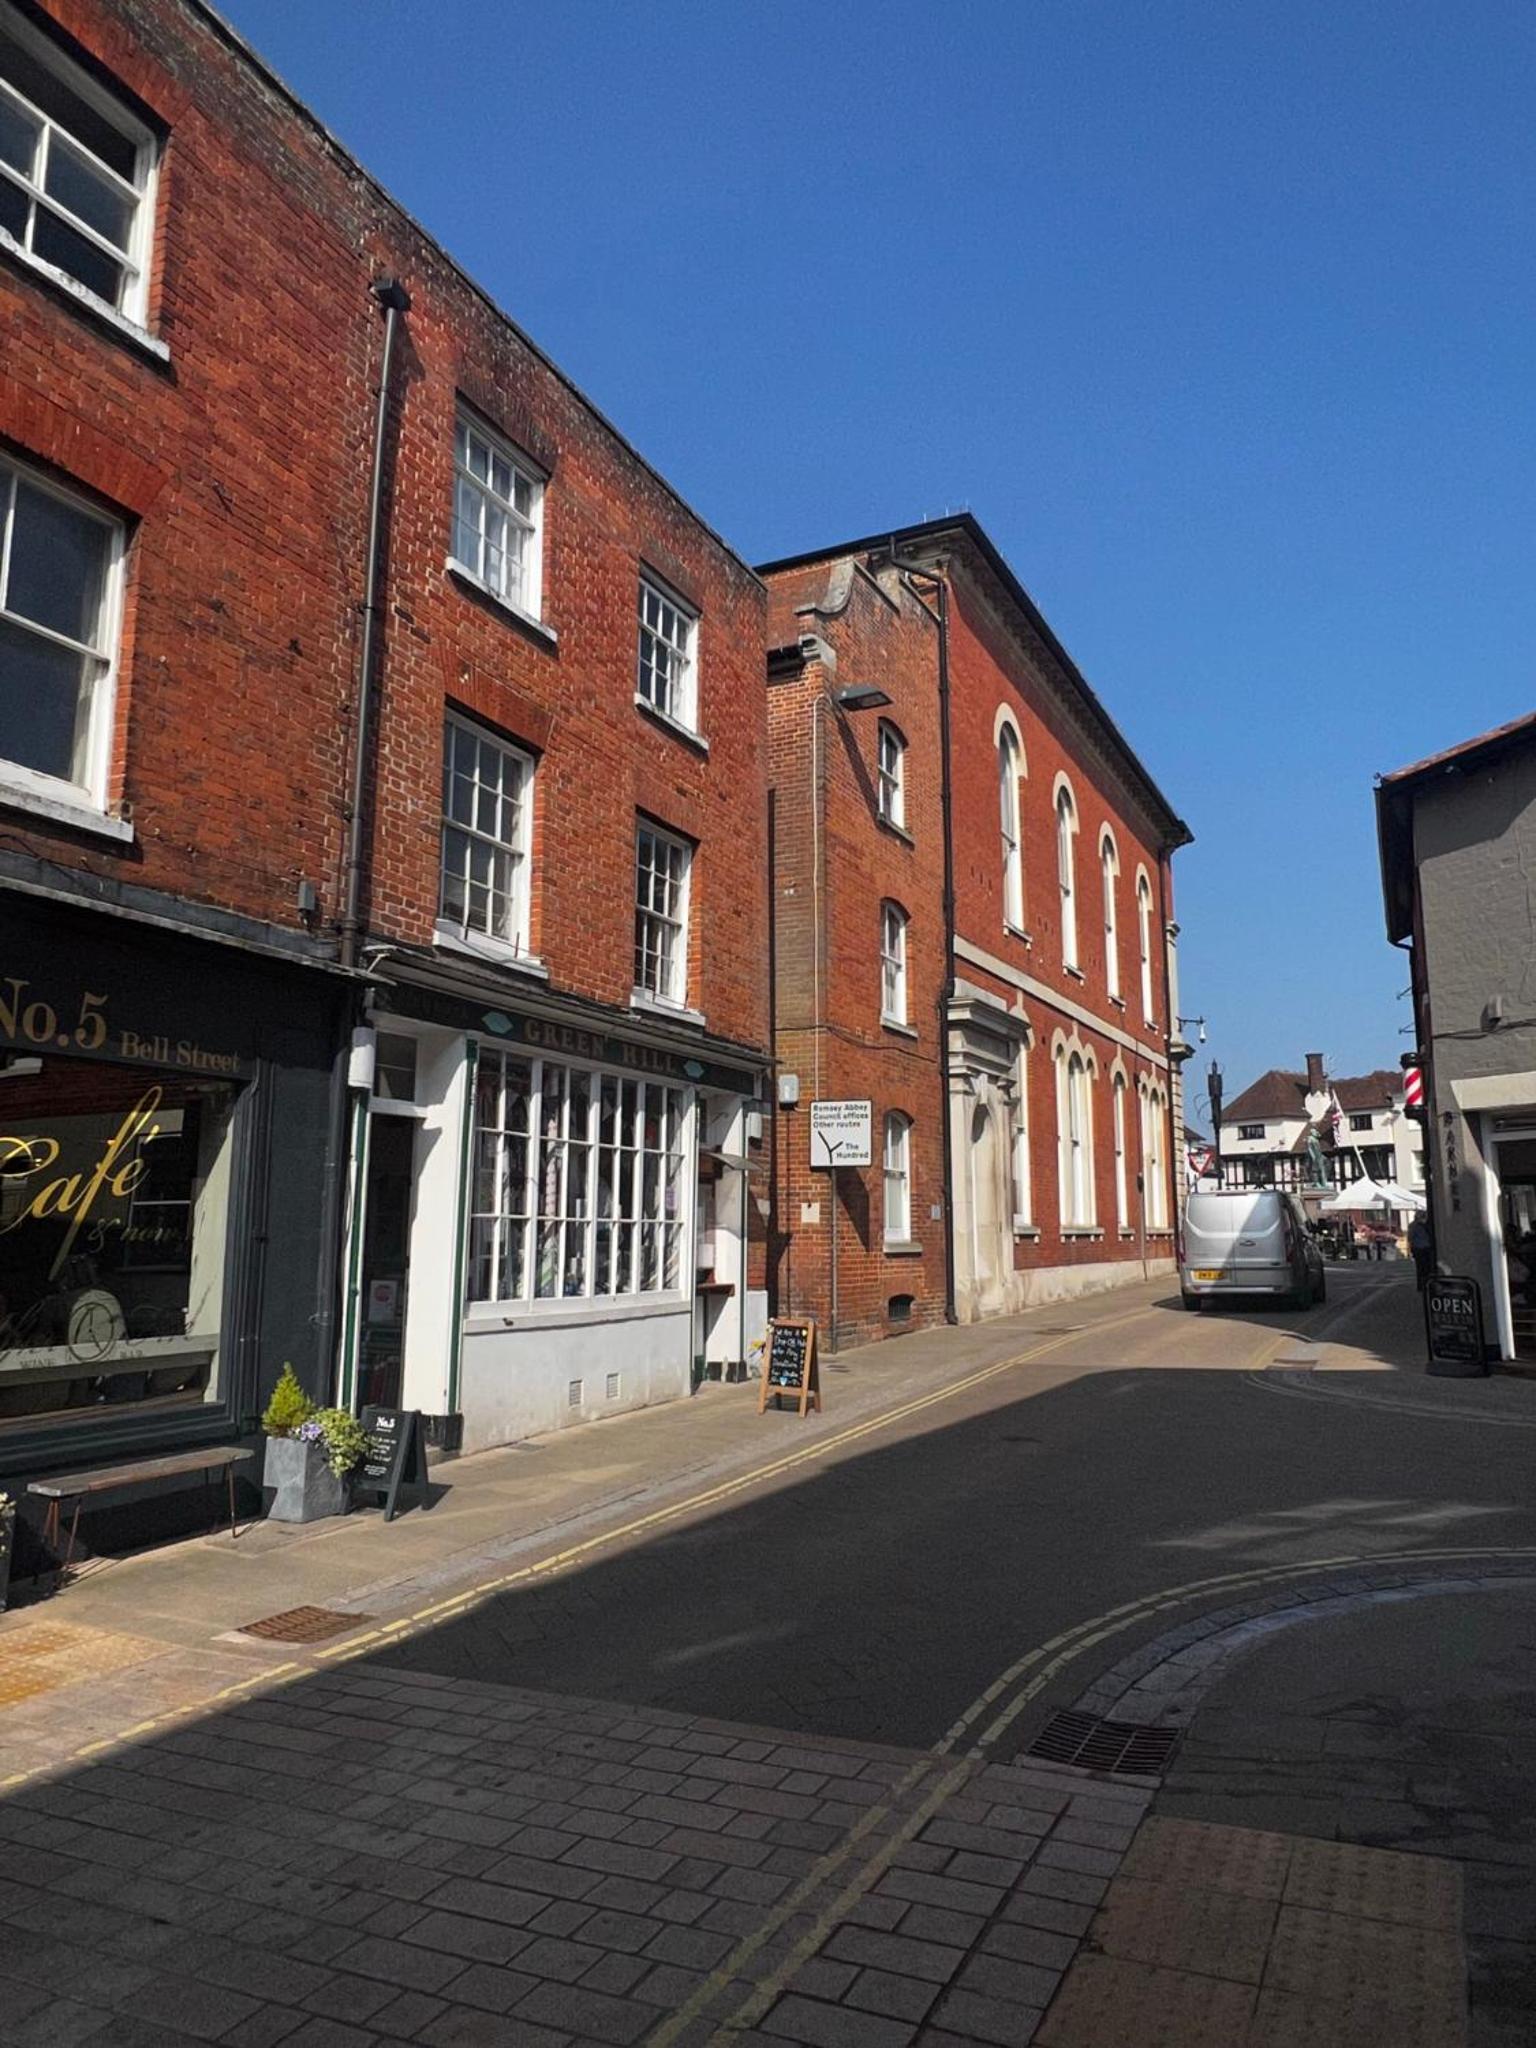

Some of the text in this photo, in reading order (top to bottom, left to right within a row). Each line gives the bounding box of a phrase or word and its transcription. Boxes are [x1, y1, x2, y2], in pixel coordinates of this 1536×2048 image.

[525, 1018, 677, 1073] GREEN HILL
[120, 1030, 240, 1073] Bell Street
[813, 1103, 868, 1112] Romsey Abbey
[843, 1112, 869, 1120] offices
[813, 1121, 861, 1129] Other routes
[836, 1151, 869, 1159] Hundred
[1431, 1297, 1473, 1314] OPEN
